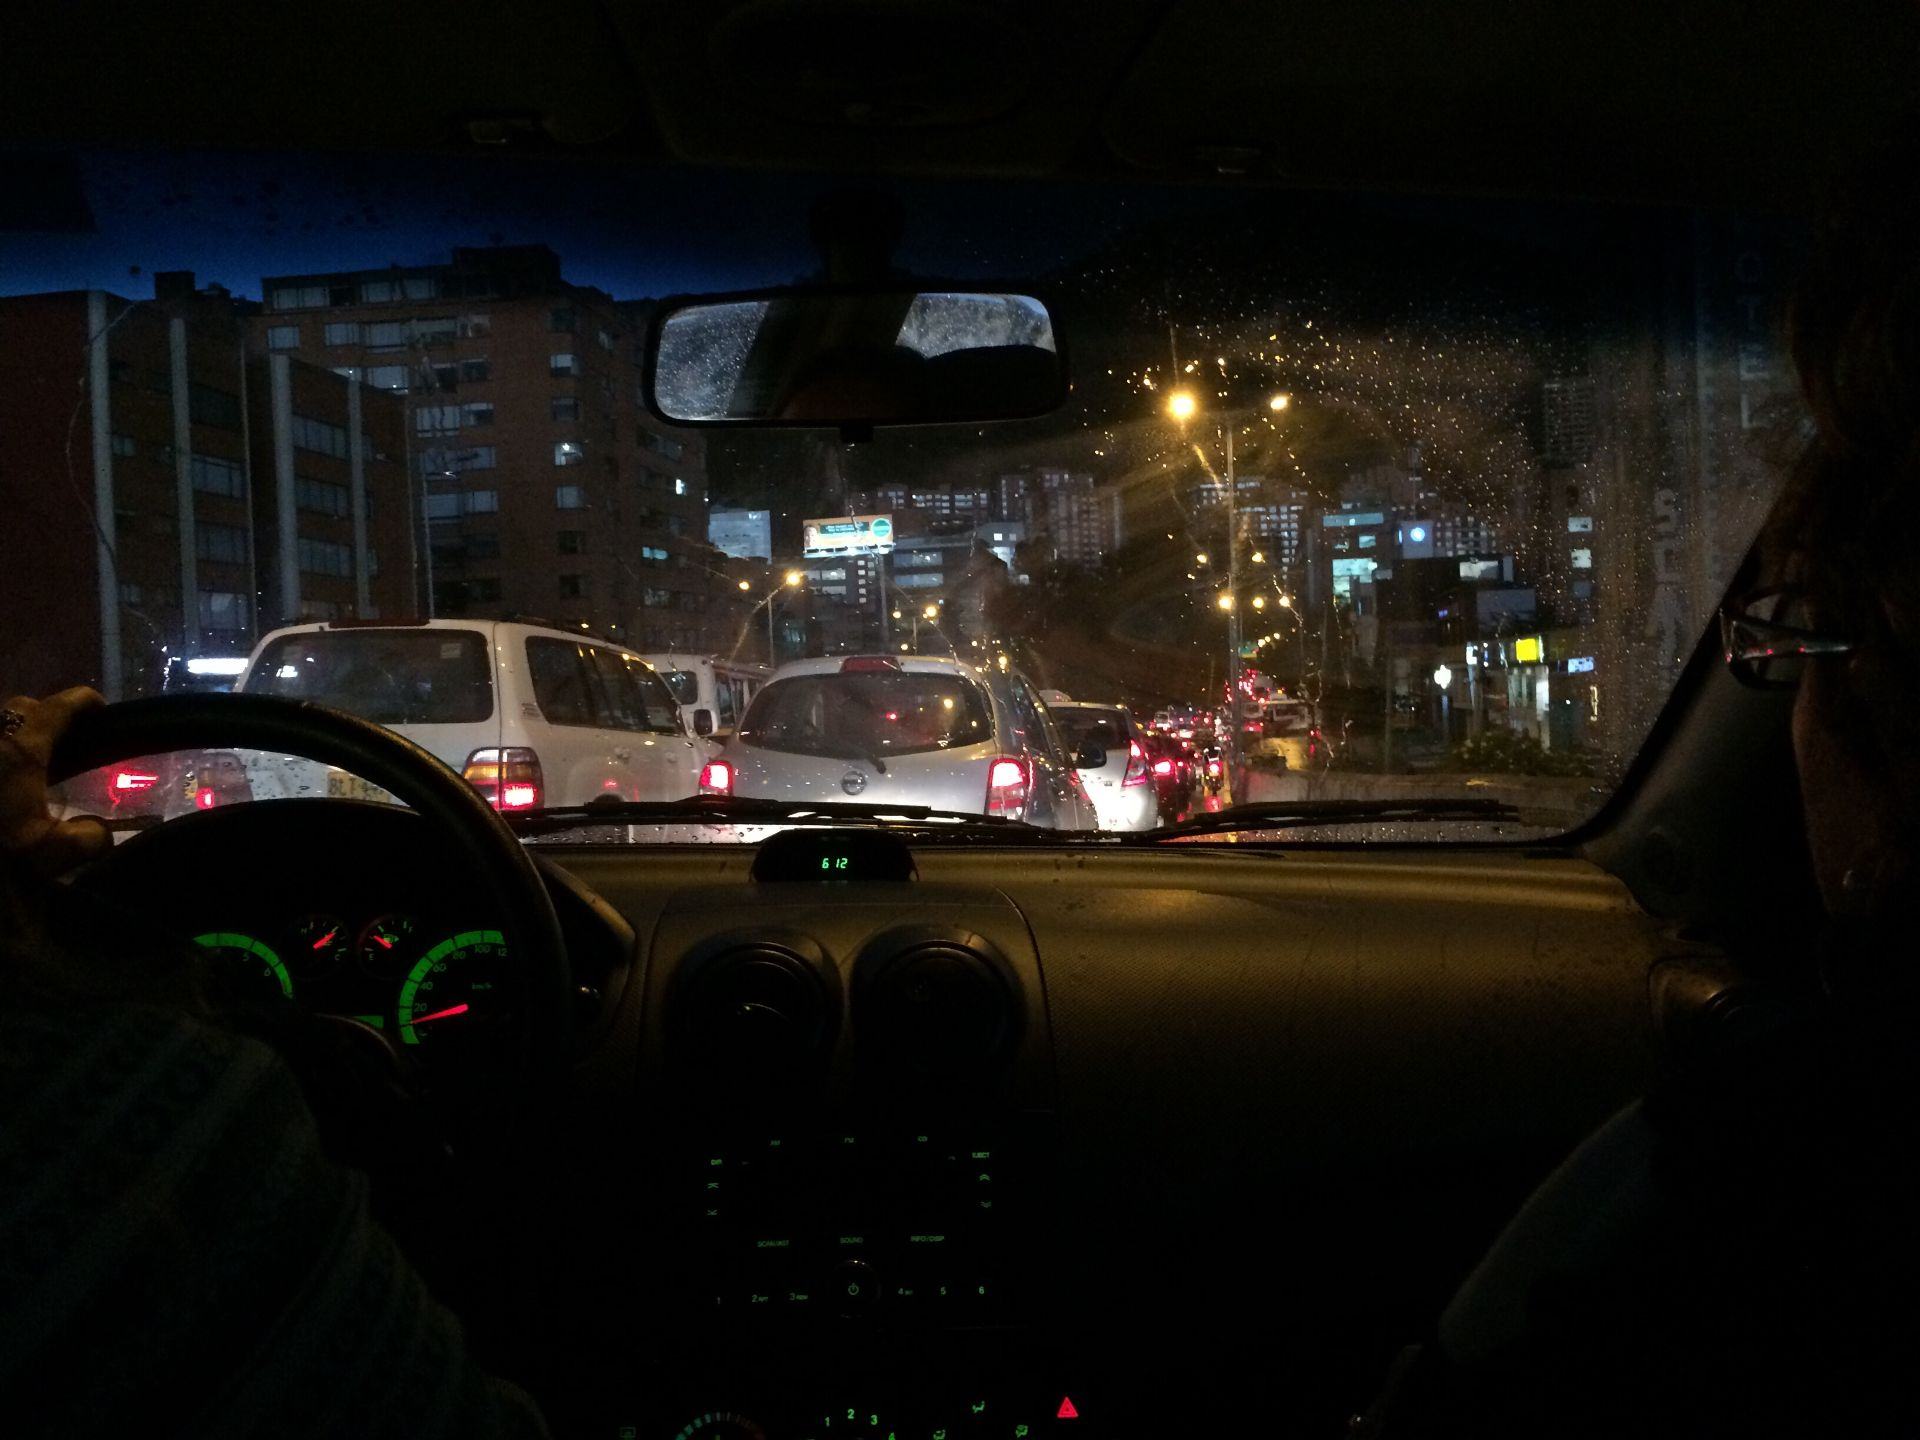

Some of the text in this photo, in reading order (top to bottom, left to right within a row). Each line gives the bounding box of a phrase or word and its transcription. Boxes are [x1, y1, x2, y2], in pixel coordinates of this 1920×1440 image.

[497, 947, 508, 957] 12
[432, 963, 447, 973] 60
[420, 981, 434, 991] 40
[413, 1002, 429, 1012] 20
[847, 1408, 856, 1420] 2
[870, 1414, 879, 1426] 3
